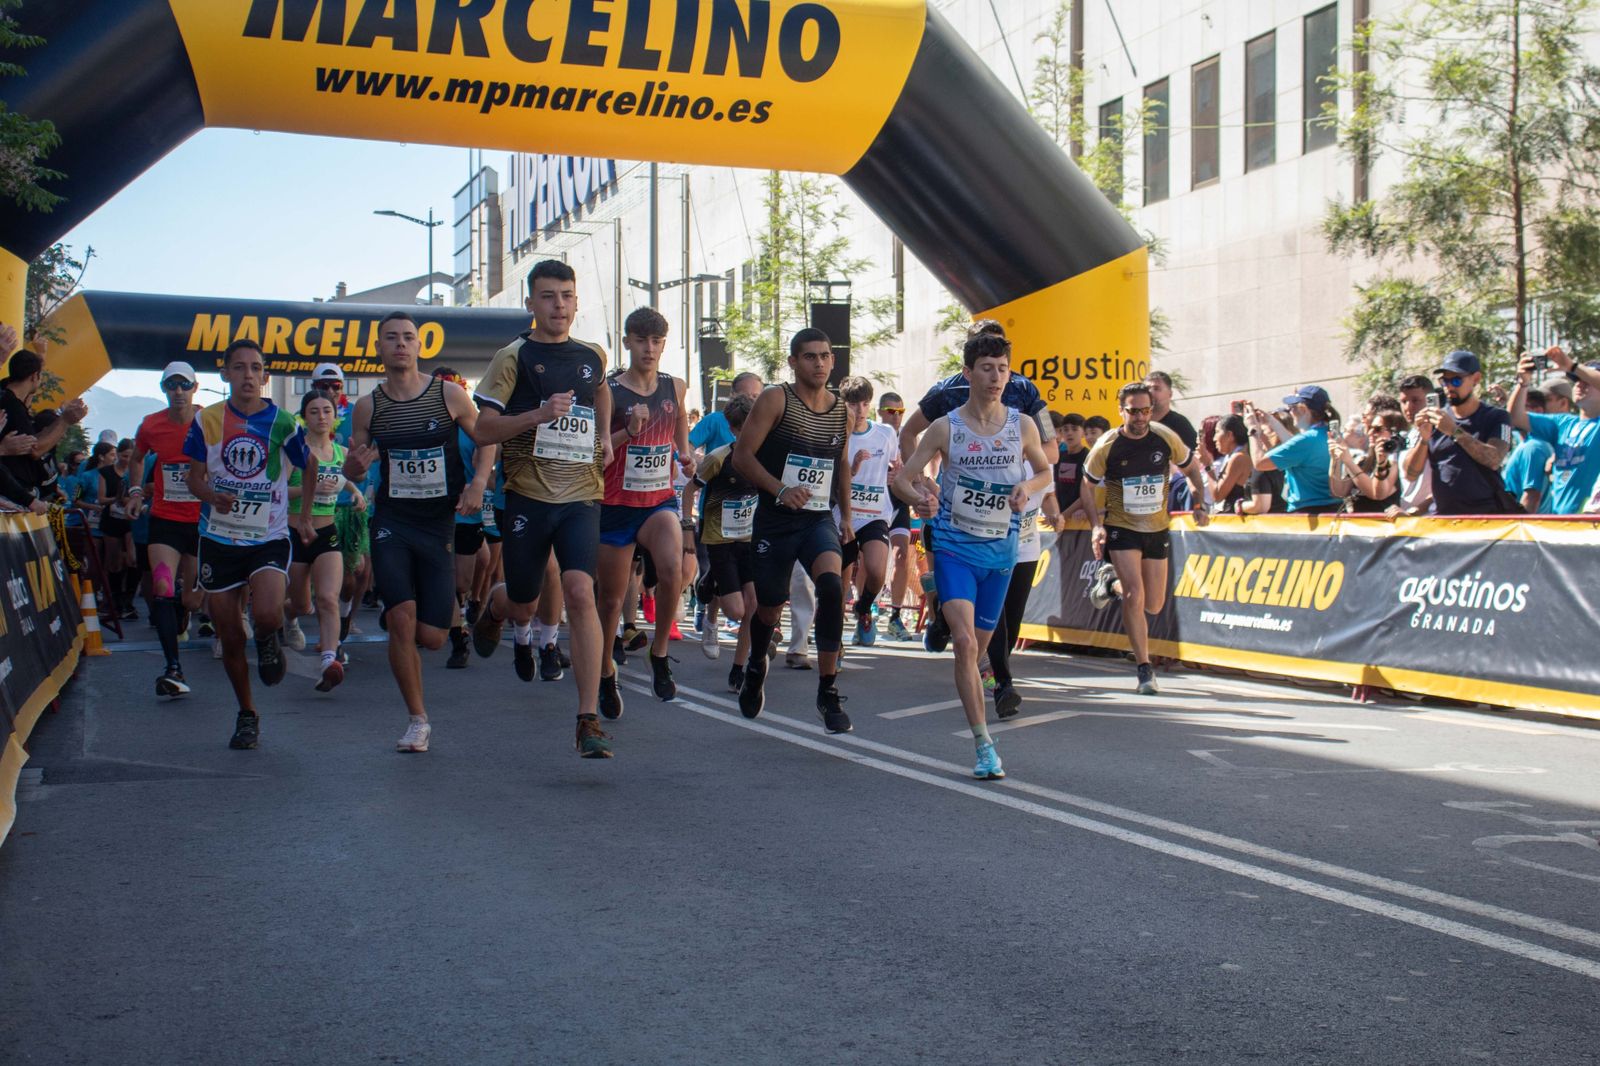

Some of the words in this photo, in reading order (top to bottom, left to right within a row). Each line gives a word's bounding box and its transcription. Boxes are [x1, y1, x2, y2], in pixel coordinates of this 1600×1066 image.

[315, 66, 773, 125] www.mpmarcelino.es
[186, 312, 446, 360] MARCELIO
[1020, 350, 1150, 389] agustino
[548, 416, 588, 433] 2090
[397, 459, 437, 474] 1613
[634, 454, 667, 469] 2508
[959, 454, 1015, 466] MARACENA
[797, 468, 825, 485] 682
[851, 490, 880, 503] 2544
[1134, 484, 1156, 496] 786
[962, 489, 1006, 511] 2546
[732, 505, 752, 521] 549
[1174, 553, 1345, 612] MARCELINO
[1399, 570, 1530, 612] agustinos
[1410, 612, 1495, 636] GRANADA
